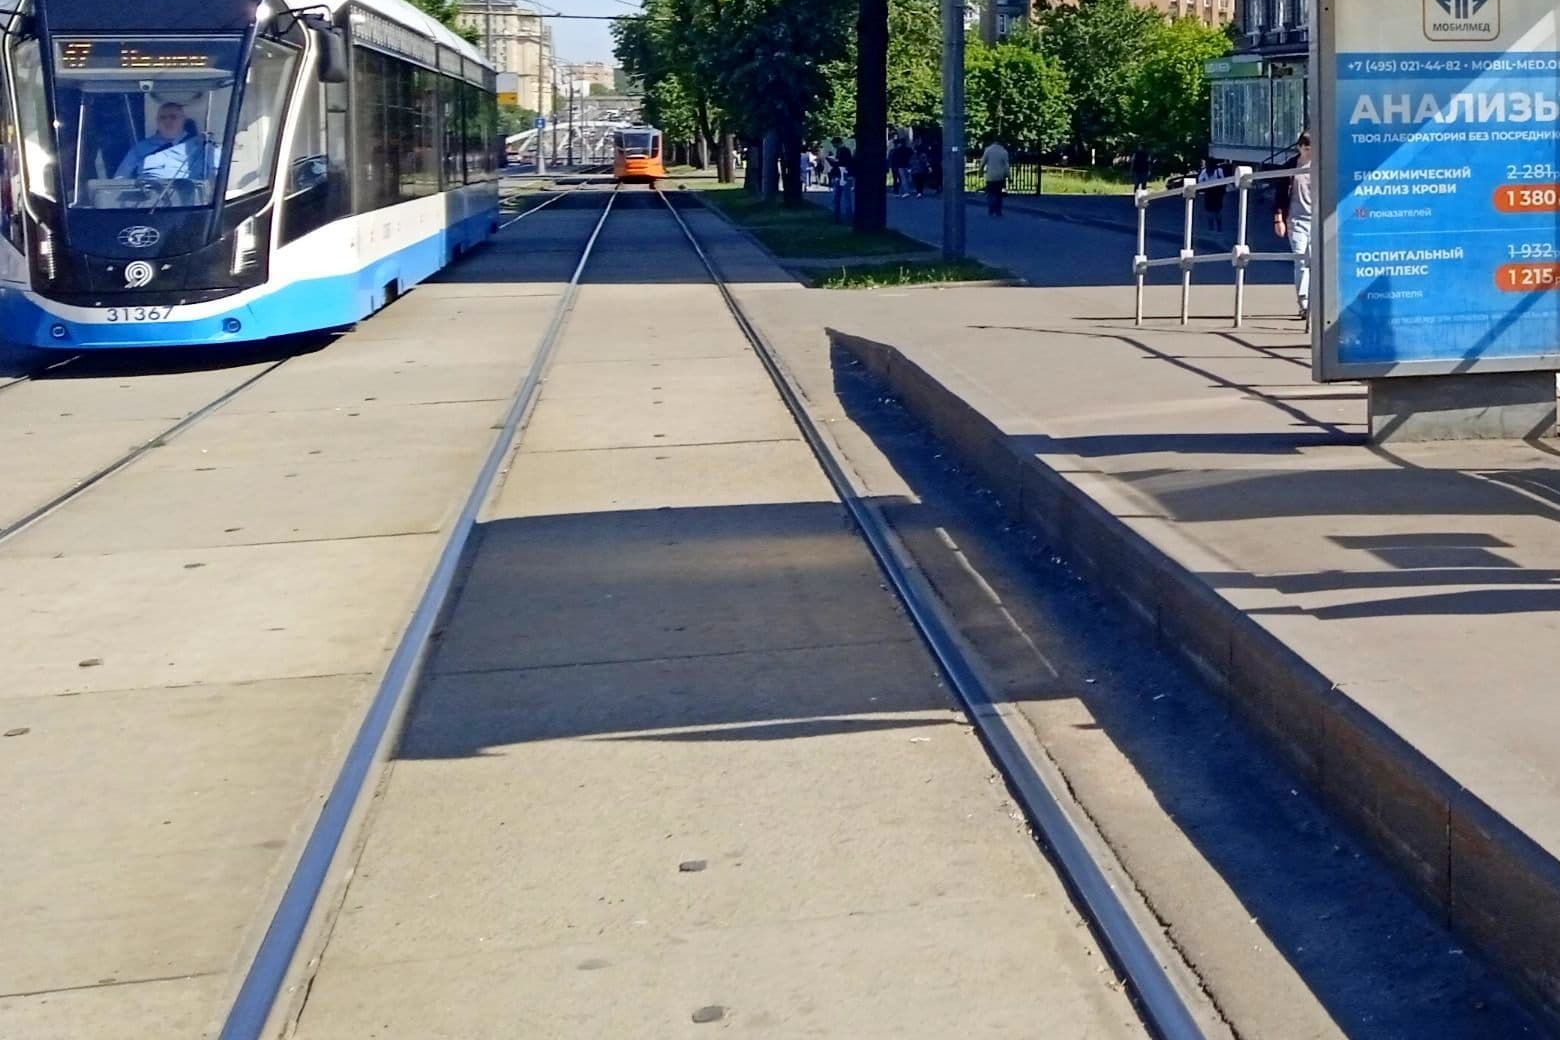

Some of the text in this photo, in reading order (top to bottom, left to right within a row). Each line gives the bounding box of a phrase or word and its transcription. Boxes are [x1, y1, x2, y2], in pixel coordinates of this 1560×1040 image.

[1433, 23, 1491, 33] МОБИЛМЕД
[1348, 61, 1362, 71] +7
[1365, 60, 1397, 72] (495)
[1400, 60, 1460, 71] 021-44-82
[1352, 134, 1381, 144] ТВОЯ
[1383, 132, 1466, 143] ЛАБОРАТОРИЯ
[1468, 131, 1489, 142] БЕЗ
[1354, 166, 1472, 181] БИОХИМИЧЕСКИЙ
[1506, 164, 1518, 179] 2
[1354, 183, 1457, 196] АНАЛИЗ КРОВИ
[1506, 190, 1515, 206] 1
[1519, 189, 1557, 206] 380
[1369, 208, 1432, 219] показателей
[1356, 247, 1464, 262] ГОСПИТАЛЬНЫЙ
[1507, 244, 1515, 259] 1
[1521, 243, 1553, 258] 932
[1356, 265, 1429, 277] КОМПЛЕКС
[1508, 269, 1516, 285] 1
[1521, 268, 1553, 285] 215
[107, 305, 174, 322] 31367
